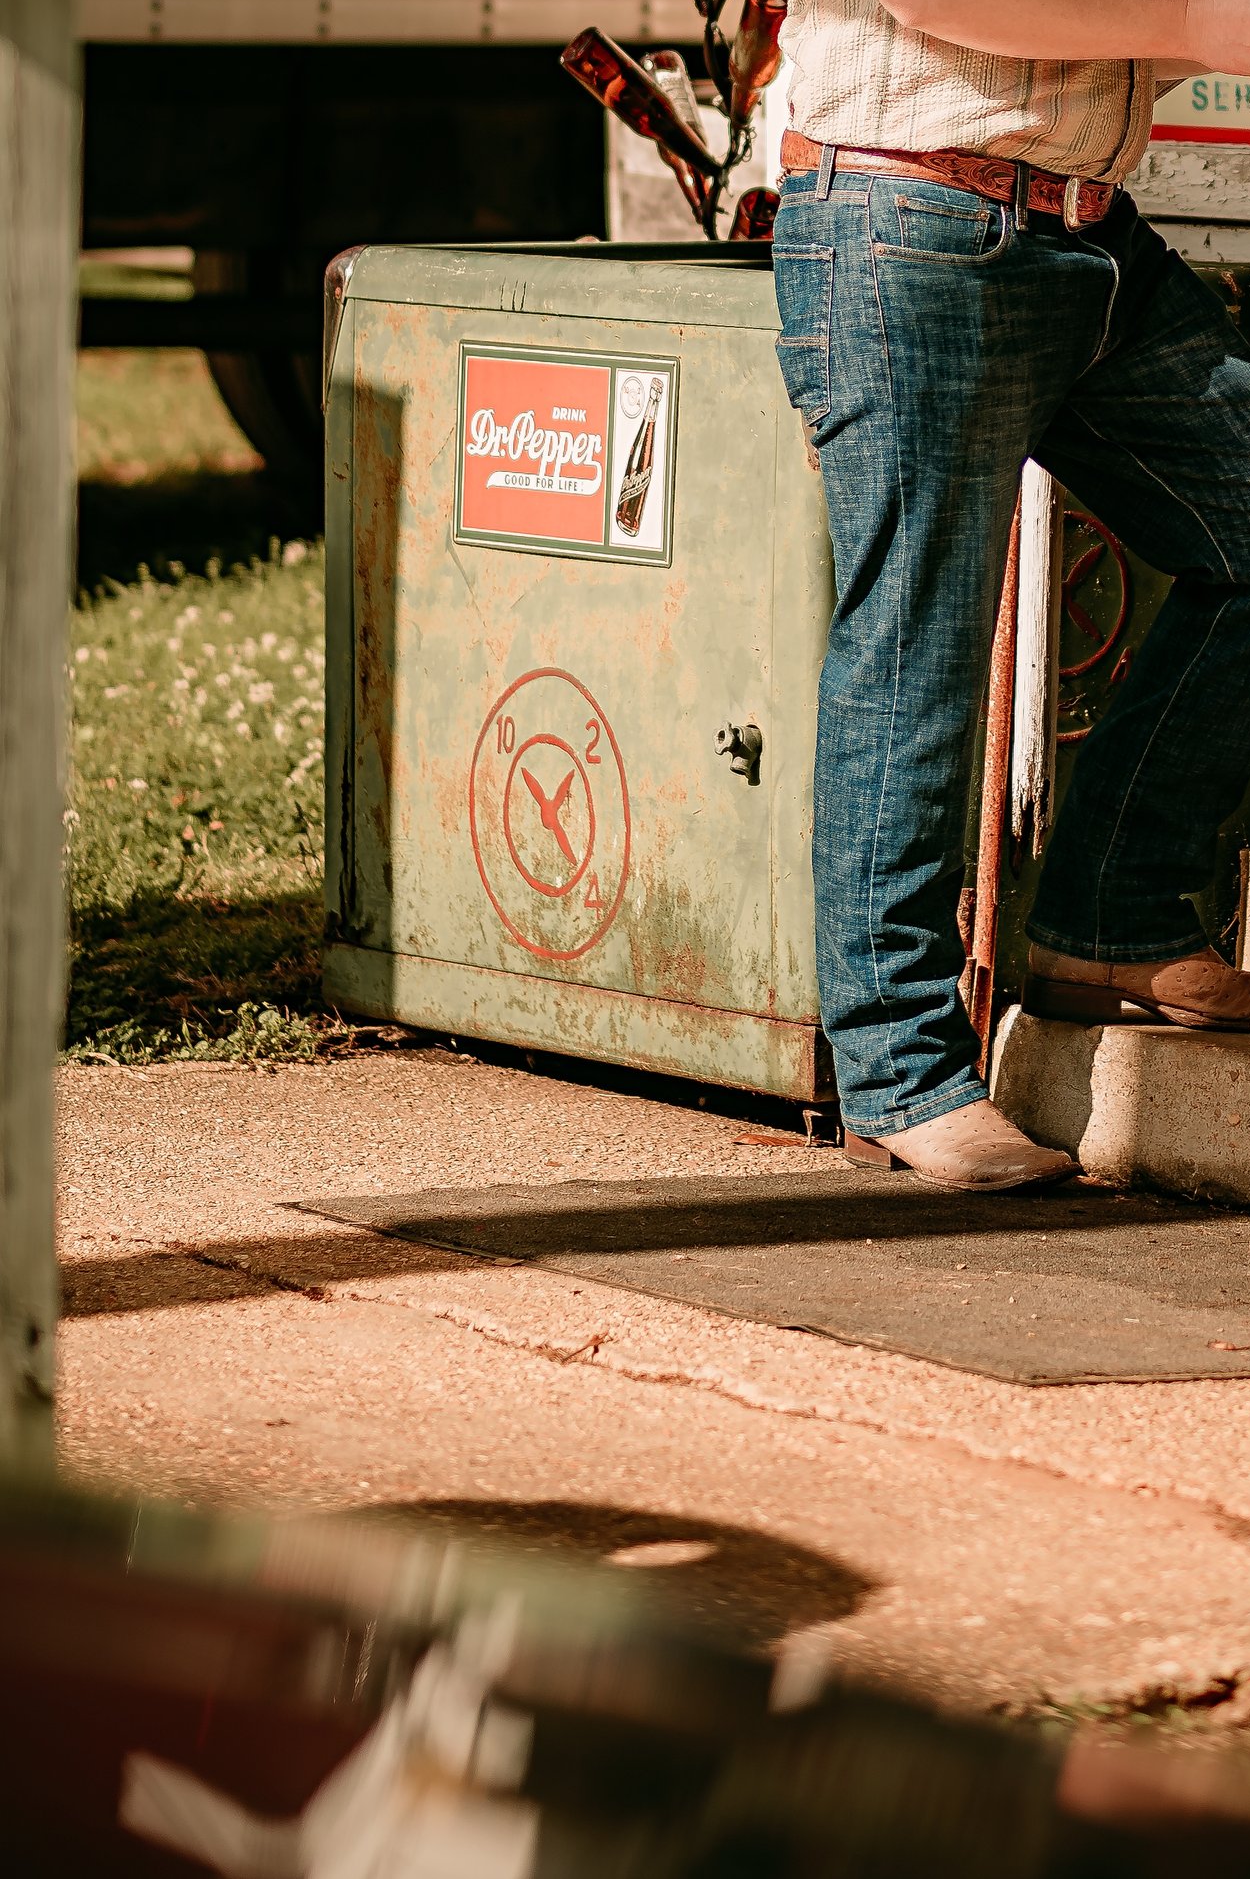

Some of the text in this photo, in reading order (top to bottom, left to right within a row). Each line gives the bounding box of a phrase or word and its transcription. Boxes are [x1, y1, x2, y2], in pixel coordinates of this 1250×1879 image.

[552, 406, 587, 422] DRINK
[504, 473, 531, 488] GOOD
[536, 478, 554, 490] FOR
[496, 715, 601, 764] 10 2
[584, 871, 605, 922] 4
